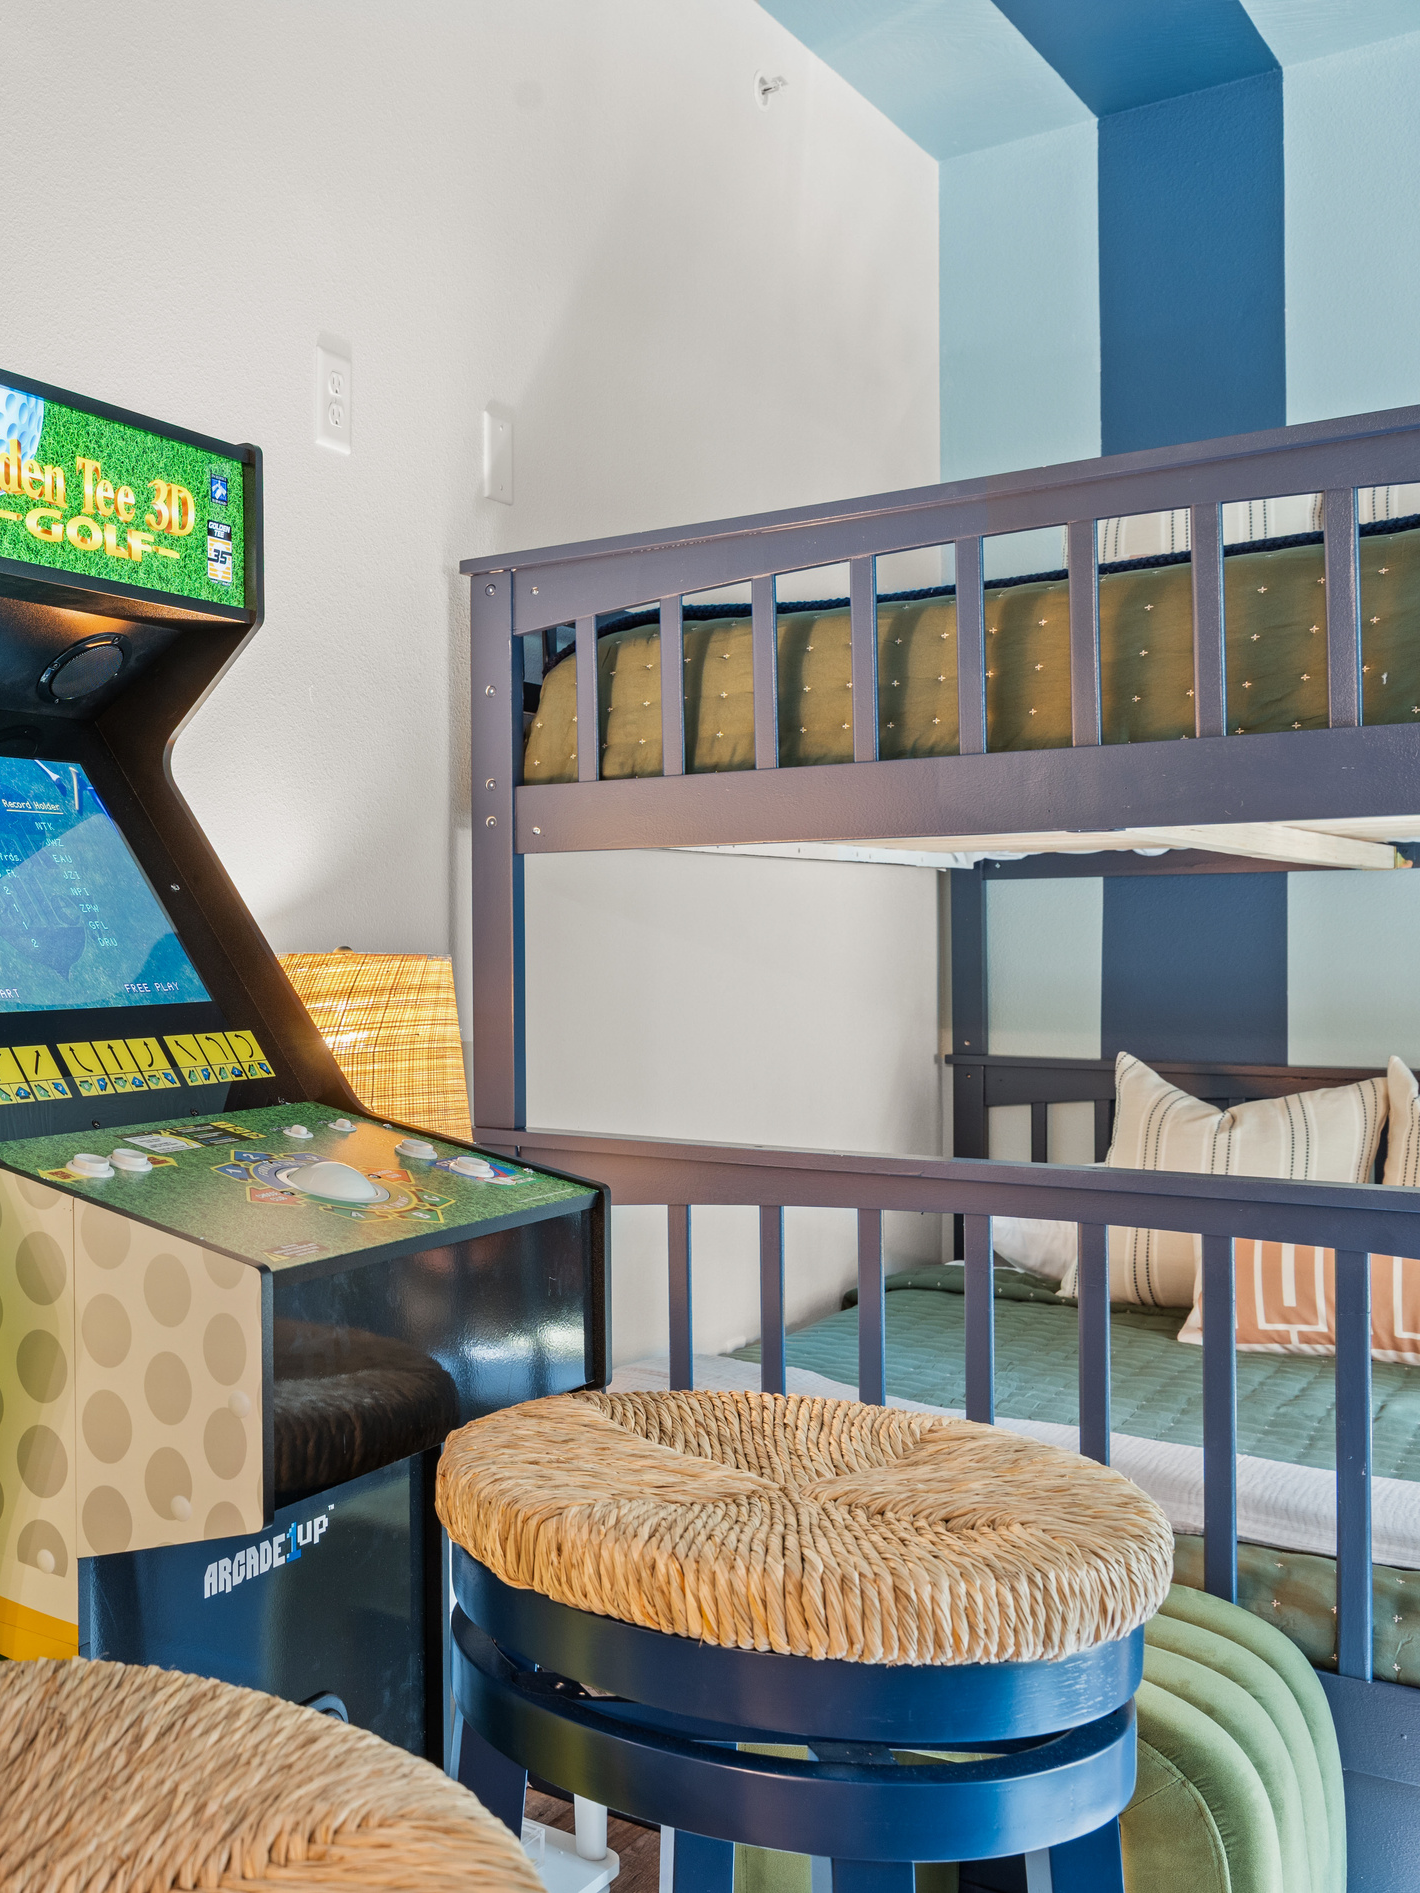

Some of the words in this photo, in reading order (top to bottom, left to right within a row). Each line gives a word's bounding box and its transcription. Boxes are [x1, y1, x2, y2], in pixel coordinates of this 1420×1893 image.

[76, 455, 136, 523] Tee
[145, 478, 195, 537] 3D
[208, 520, 231, 534] GOLDEN
[213, 529, 225, 539] TEE
[213, 548, 228, 565] 35
[2, 798, 31, 810] Record
[34, 801, 60, 811] Holder
[35, 821, 55, 831] NTK
[45, 838, 64, 847] JWZ
[53, 854, 72, 864] EAU
[3, 886, 11, 895] 2
[70, 887, 90, 896] NPI
[79, 903, 99, 913] ZPW
[88, 920, 108, 930] GFL
[31, 938, 39, 948] 2
[124, 983, 151, 993] FREE
[155, 981, 180, 992] PLAY
